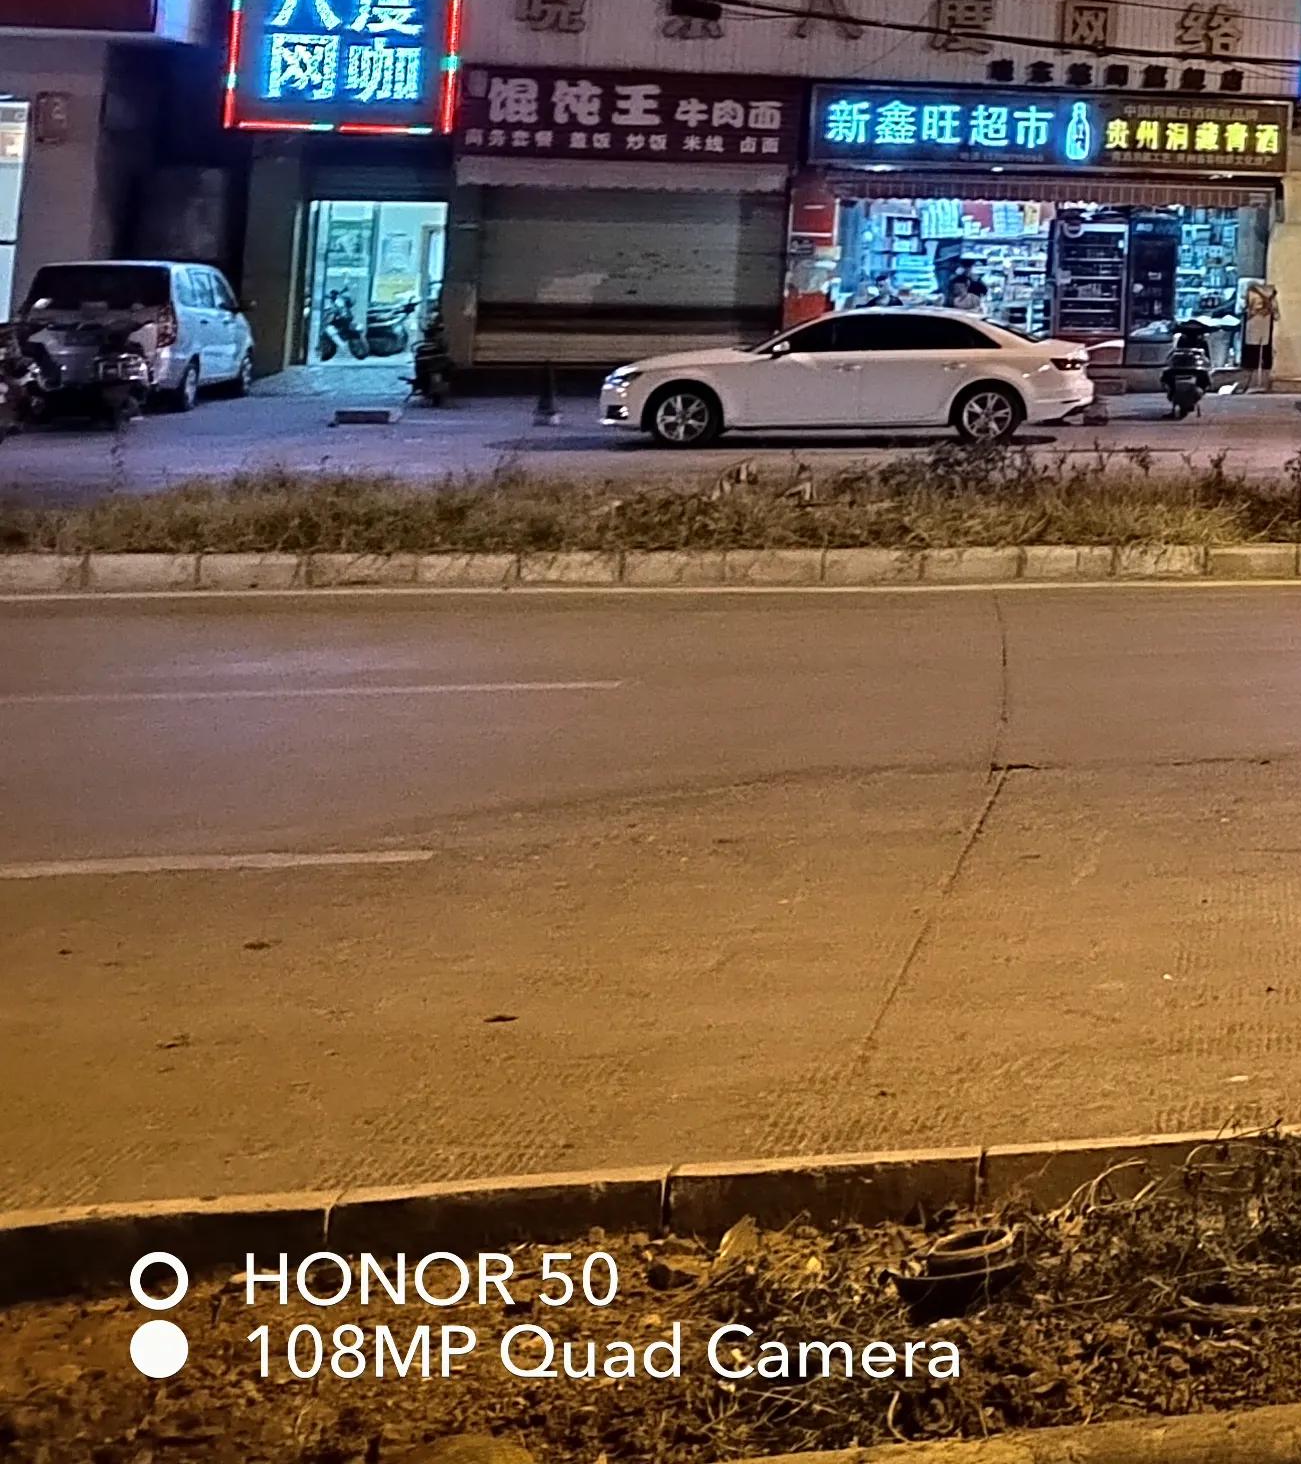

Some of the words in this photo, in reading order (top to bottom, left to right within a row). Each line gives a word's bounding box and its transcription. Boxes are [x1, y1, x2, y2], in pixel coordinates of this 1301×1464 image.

[266, 33, 422, 101] 网咖
[488, 77, 662, 126] 馄饨王
[675, 98, 783, 130] 牛肉面
[825, 99, 1056, 149] 新鑫旺超市
